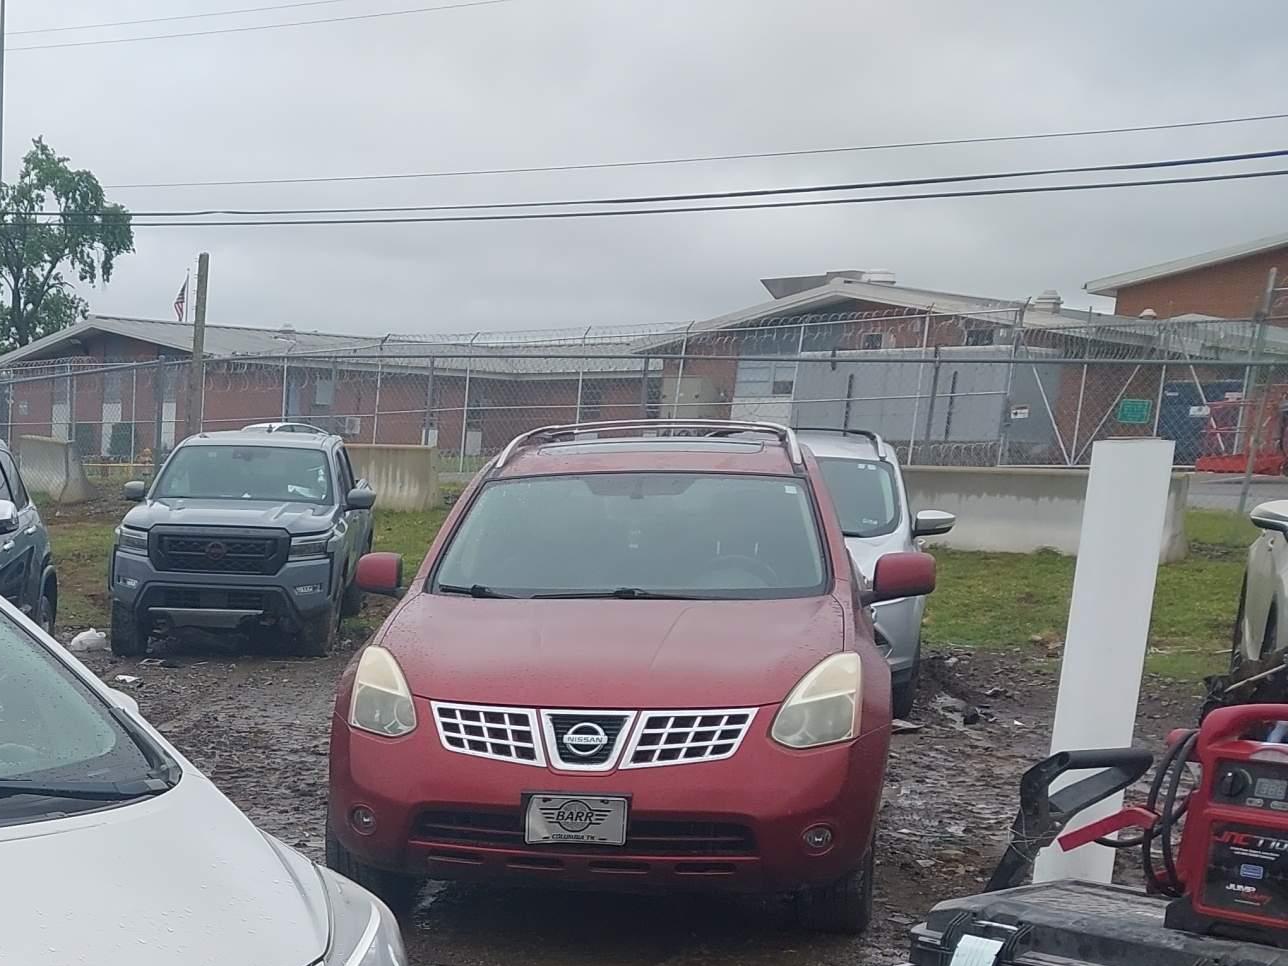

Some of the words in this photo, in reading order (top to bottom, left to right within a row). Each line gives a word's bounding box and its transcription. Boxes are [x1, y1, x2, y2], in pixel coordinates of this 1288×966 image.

[567, 736, 603, 744] NISSAN
[556, 811, 594, 822] BARR
[551, 833, 585, 841] COLUMBIA
[1225, 883, 1257, 893] JUMP
